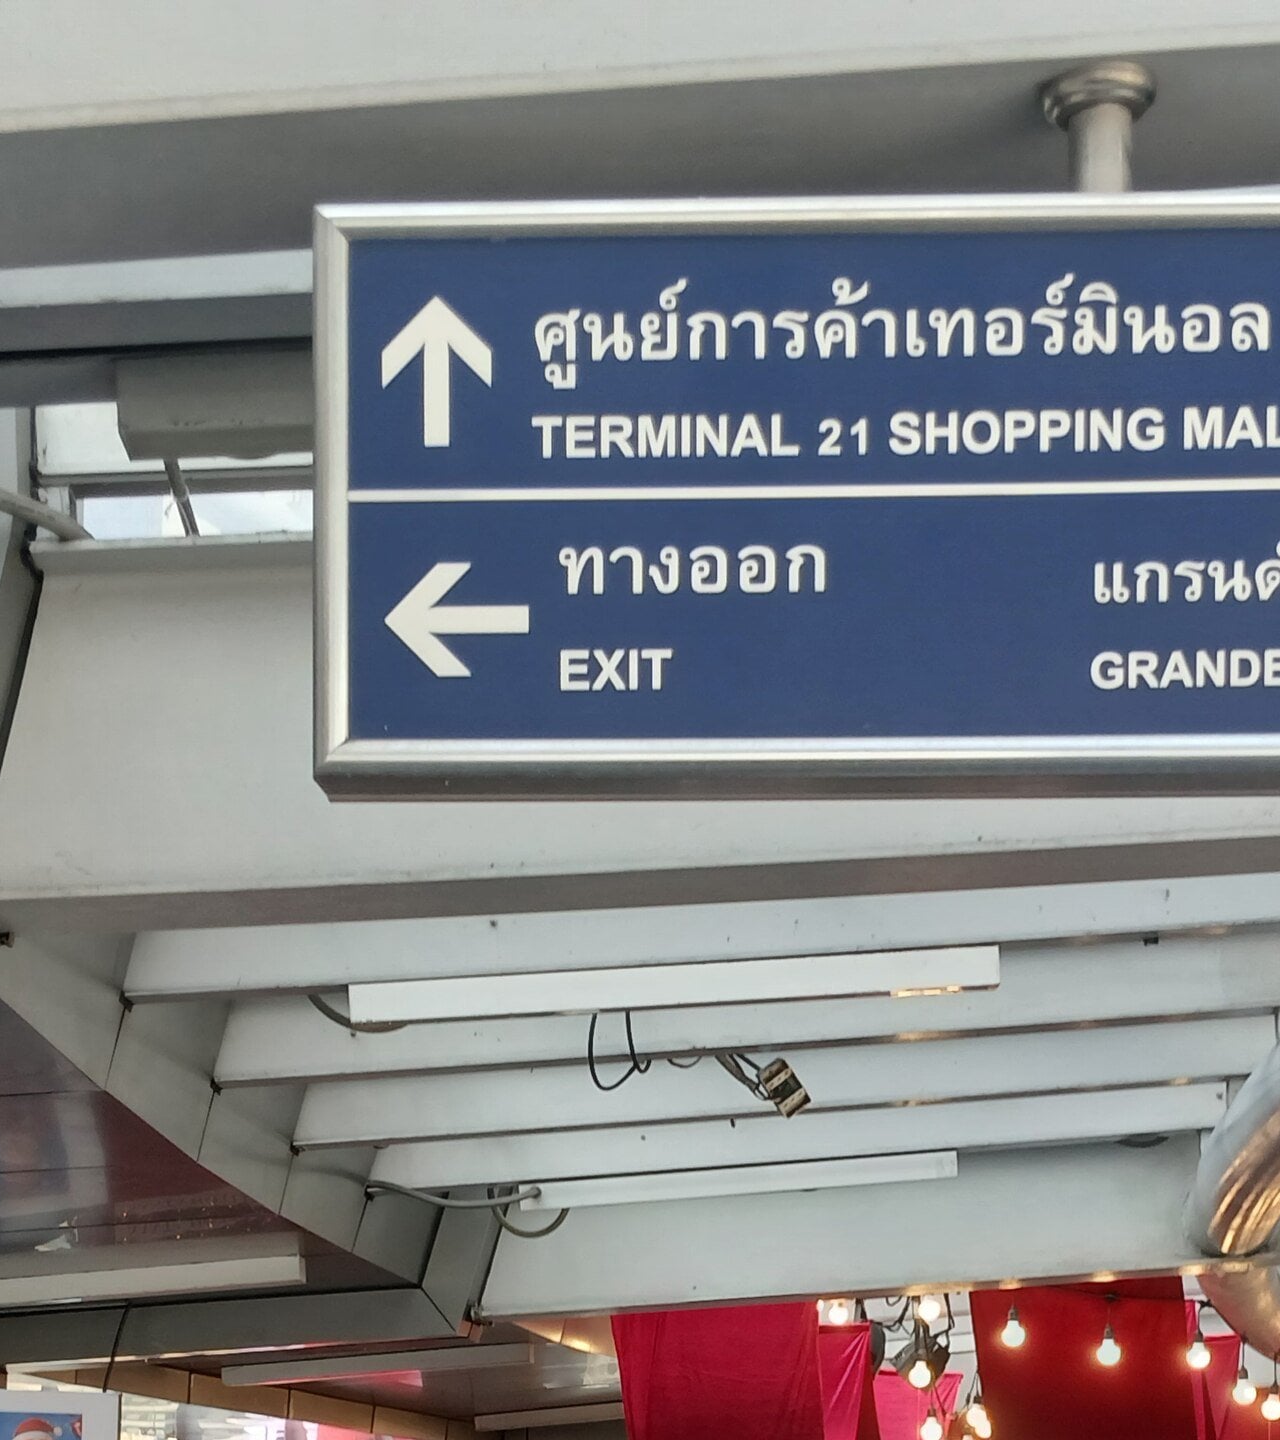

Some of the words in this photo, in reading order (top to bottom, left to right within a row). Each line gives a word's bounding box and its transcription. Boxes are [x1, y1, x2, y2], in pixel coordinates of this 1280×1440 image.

[533, 271, 1270, 390] ศูนย์การค้าเทอร์มินอล
[530, 413, 801, 460] TERMINAL
[817, 418, 869, 456] 21
[888, 407, 1166, 456] SHOPPING
[559, 542, 827, 597] ทางออก
[559, 648, 674, 692] EXIT
